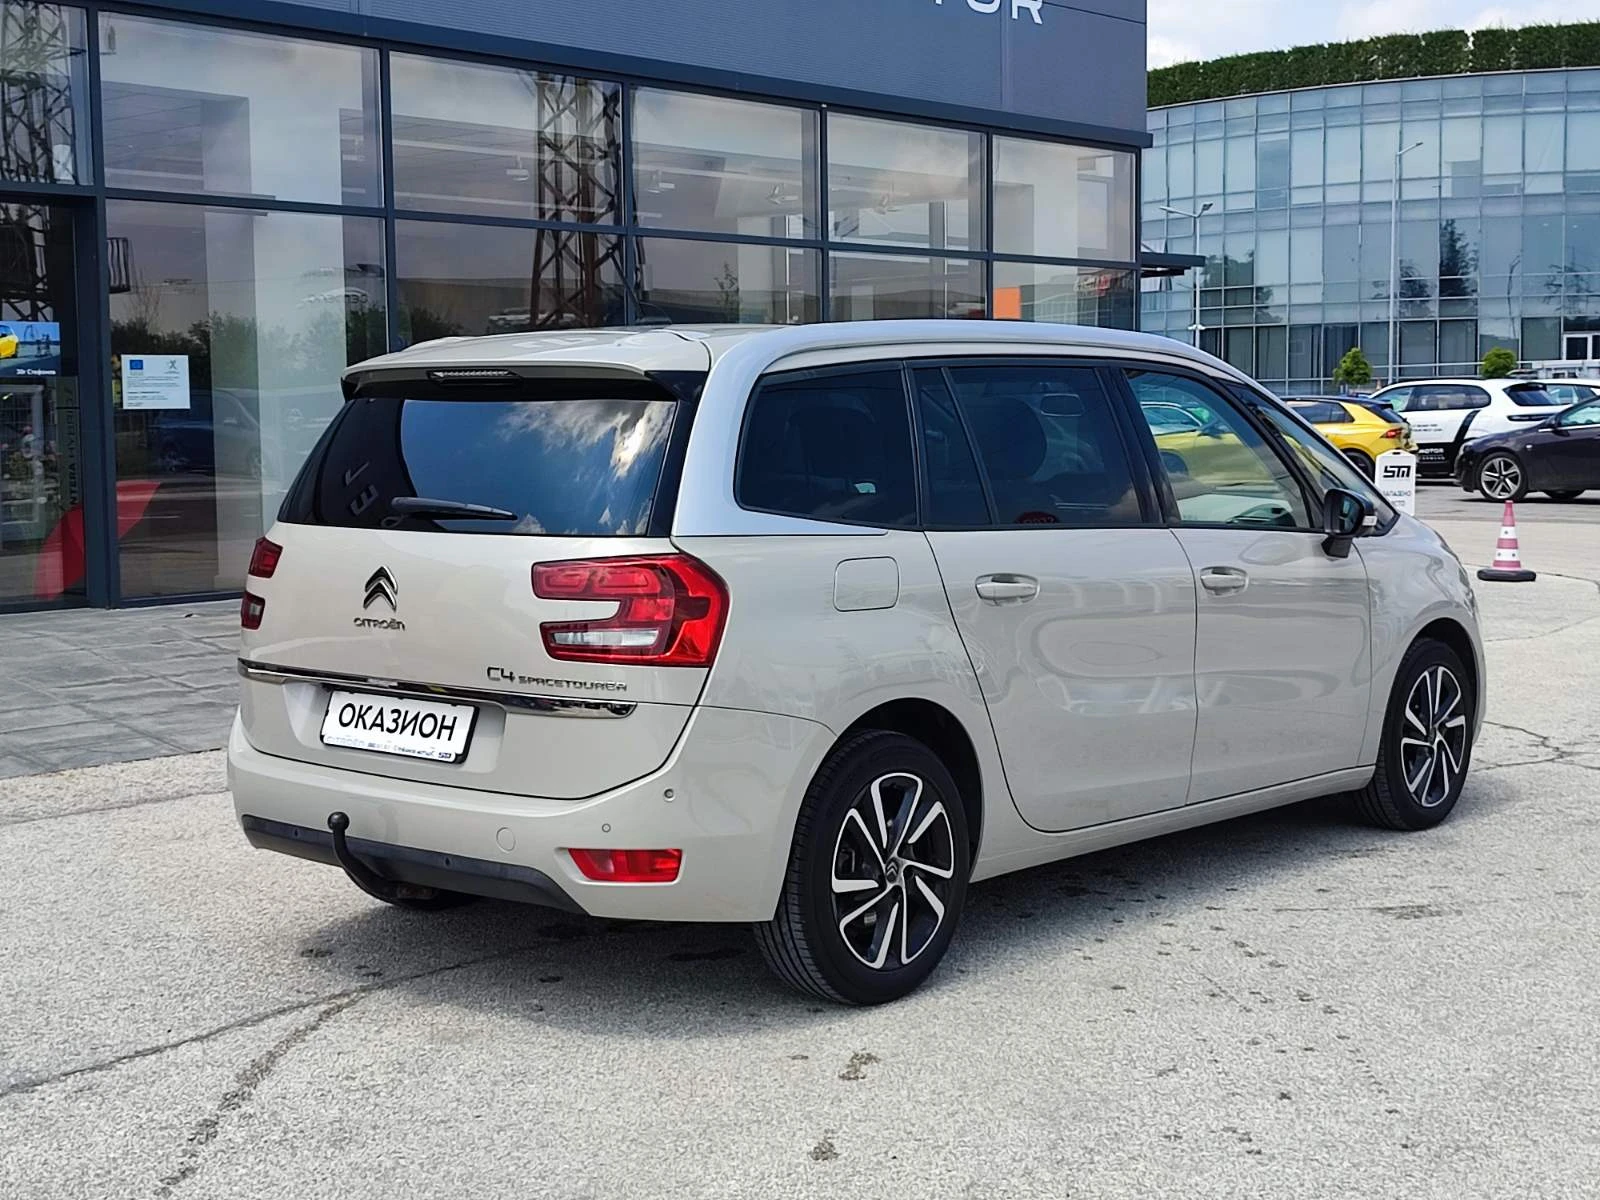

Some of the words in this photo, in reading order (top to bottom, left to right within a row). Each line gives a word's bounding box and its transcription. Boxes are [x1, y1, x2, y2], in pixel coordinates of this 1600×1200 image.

[486, 666, 516, 683] C4
[518, 675, 628, 692] SPACETOURER
[338, 702, 458, 742] ОКАЗИОН
